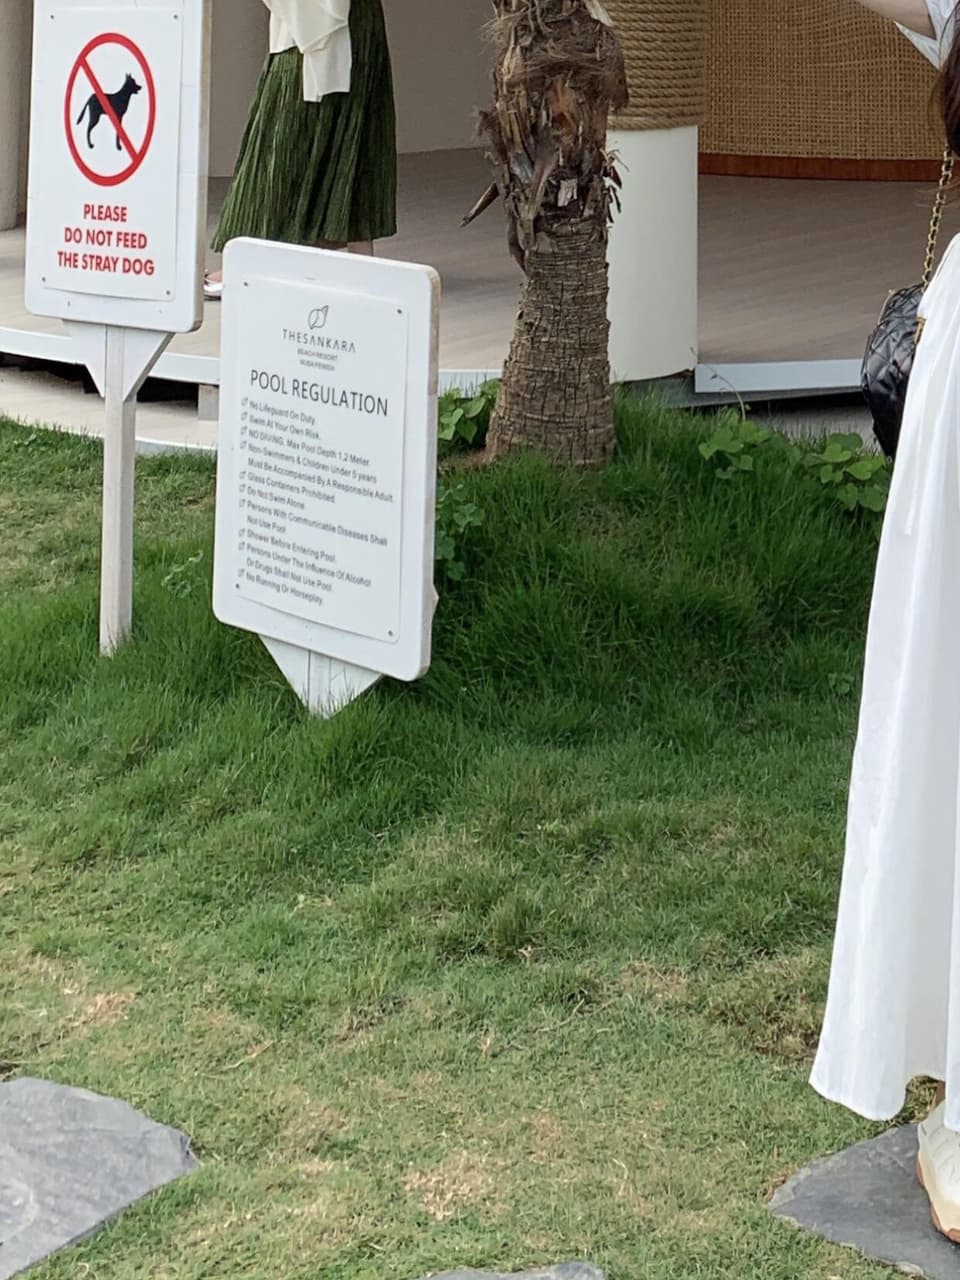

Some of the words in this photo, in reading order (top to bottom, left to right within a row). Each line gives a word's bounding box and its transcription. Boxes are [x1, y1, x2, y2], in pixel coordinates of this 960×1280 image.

[83, 204, 127, 222] PLEASE
[64, 227, 82, 243] DO
[86, 230, 112, 247] NOT
[116, 232, 147, 249] FEED
[57, 251, 78, 268] THE
[82, 255, 119, 273] STRAY
[122, 258, 154, 276] DOG
[250, 369, 288, 395] POOL
[292, 378, 388, 417] REGULATION
[250, 400, 257, 410] No
[259, 402, 288, 420] Lifeguard
[290, 409, 299, 419] On
[300, 411, 315, 426] Duty
[274, 420, 288, 432] Your
[289, 424, 303, 435] Own
[249, 429, 258, 439] NO
[287, 438, 299, 449] Max
[301, 441, 315, 453] Pool
[316, 445, 336, 460] Depth
[349, 453, 369, 466] Meter
[263, 461, 272, 471] Be
[317, 474, 325, 487] By
[302, 456, 329, 471] Children
[330, 463, 350, 477] Under
[357, 470, 376, 486] years
[247, 486, 256, 496] Do
[256, 488, 268, 499] Not
[269, 492, 285, 504] Swim
[247, 500, 272, 515] Persons
[337, 525, 368, 541] Diseases
[246, 543, 270, 558] Persons
[272, 551, 291, 564] Under
[270, 535, 291, 550] Before
[291, 541, 319, 560] Entering
[254, 559, 272, 576] Drugs
